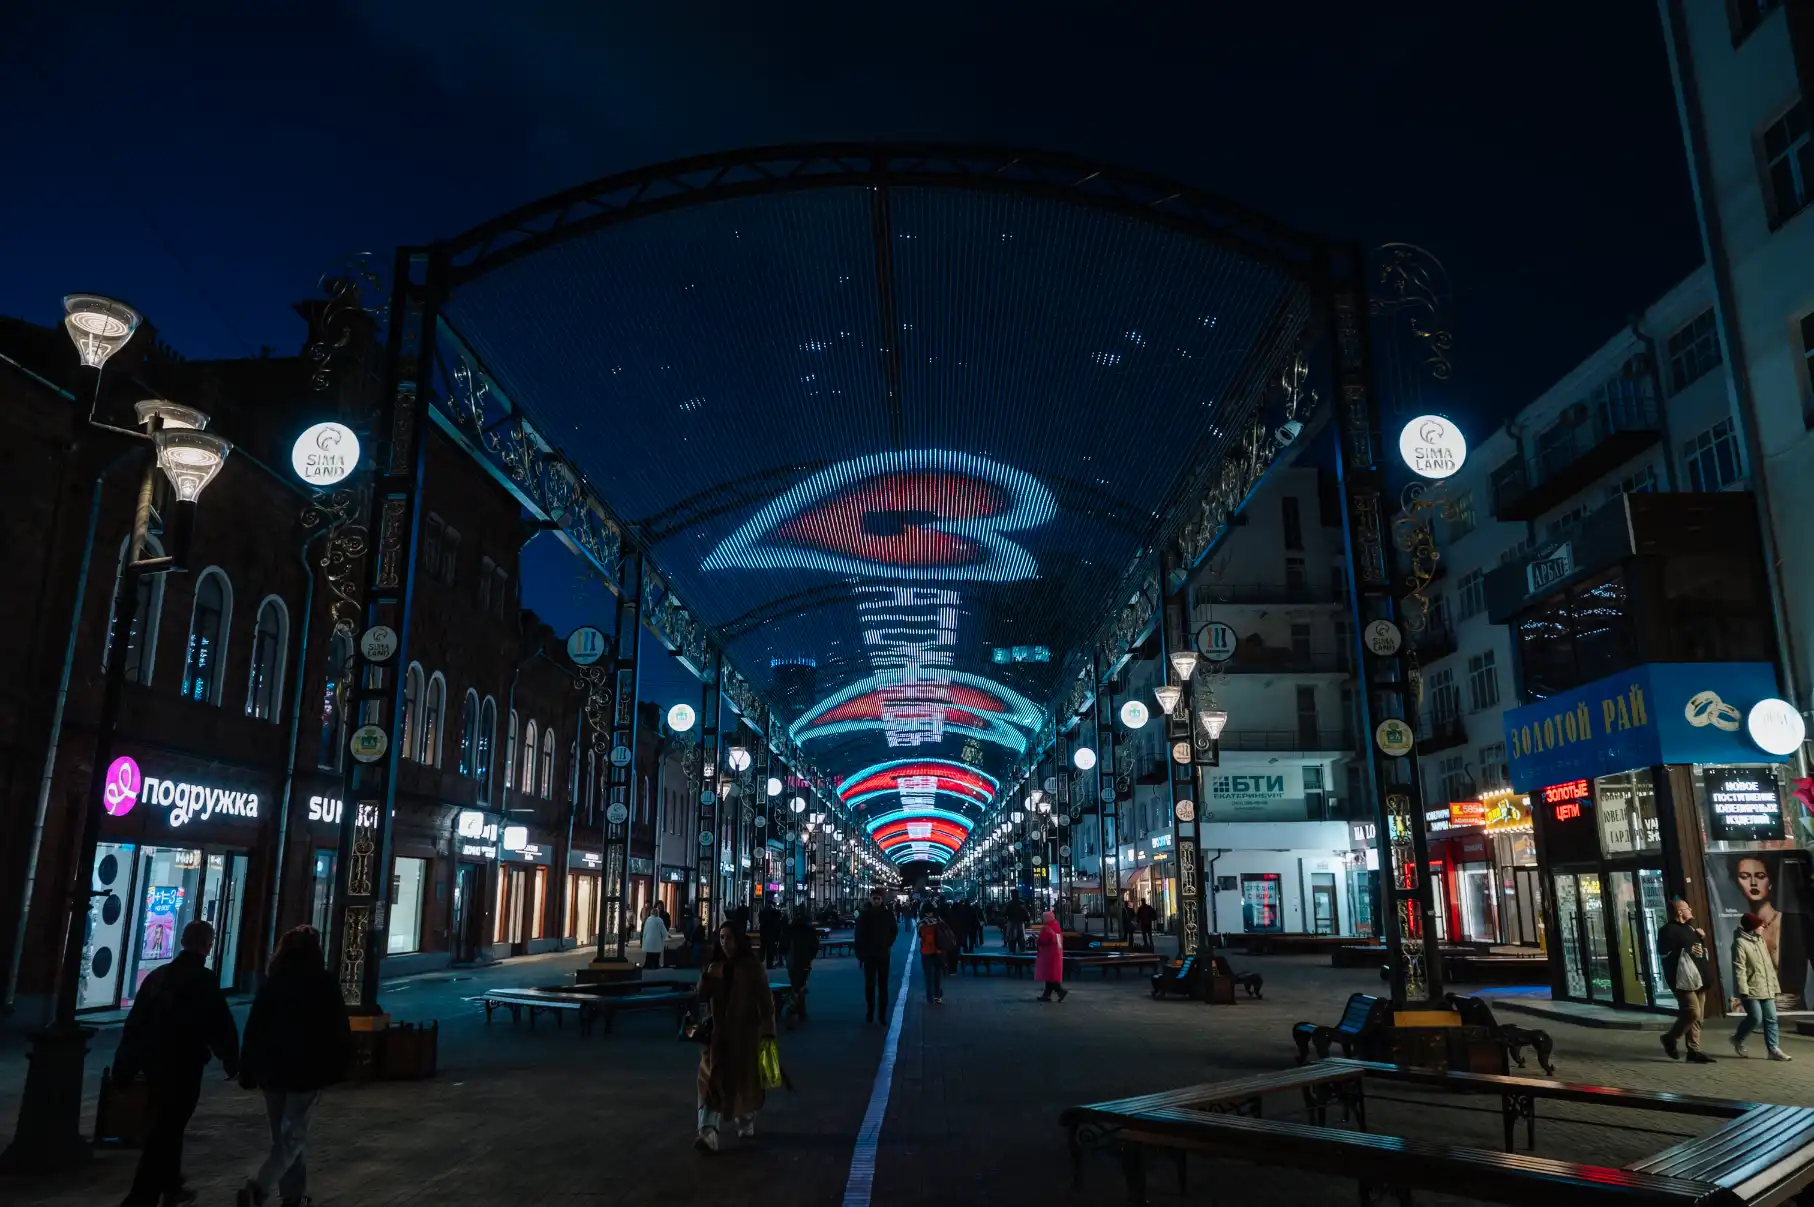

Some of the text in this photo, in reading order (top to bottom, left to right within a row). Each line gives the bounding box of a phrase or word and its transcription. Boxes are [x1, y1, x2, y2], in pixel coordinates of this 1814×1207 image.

[1415, 447, 1453, 459] SIMA
[306, 454, 345, 466] SIMA
[1416, 459, 1456, 471] LAND
[305, 466, 345, 477] LAND
[1511, 702, 1592, 760] ЗОЛОТОЙ
[1602, 683, 1648, 734] РАЙ
[1232, 775, 1284, 792] БТИ
[1725, 781, 1760, 791] НОВОЕ
[1546, 783, 1589, 802] ЗОЛОТЫЕ
[1556, 804, 1581, 822] ЦЕПИ
